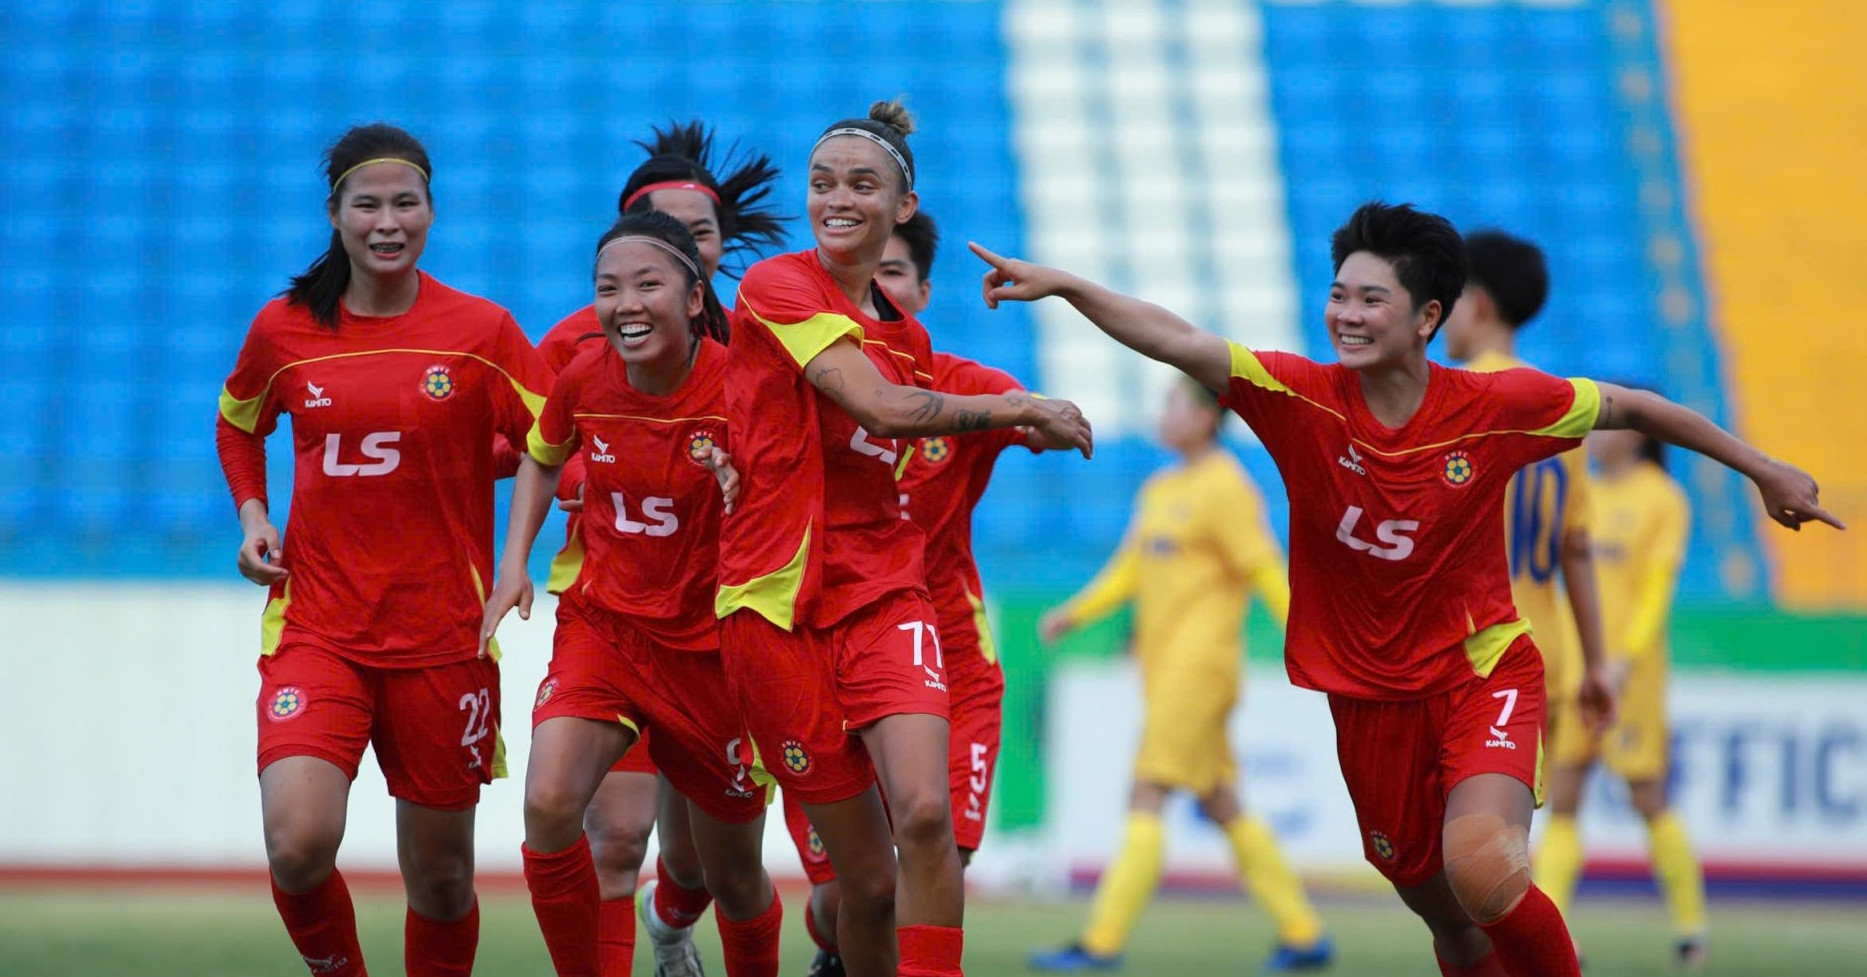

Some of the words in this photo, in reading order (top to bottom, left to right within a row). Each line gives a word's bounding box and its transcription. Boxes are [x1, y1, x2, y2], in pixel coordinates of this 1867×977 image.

[322, 431, 401, 477] LS
[1338, 456, 1366, 475] KAMITO
[611, 492, 679, 537] LS
[1336, 505, 1420, 561] LS
[1511, 457, 1568, 583] 10
[459, 688, 490, 747] 22
[1492, 688, 1518, 727] 7
[970, 742, 988, 794] 5
[1485, 740, 1516, 750] KAMITO
